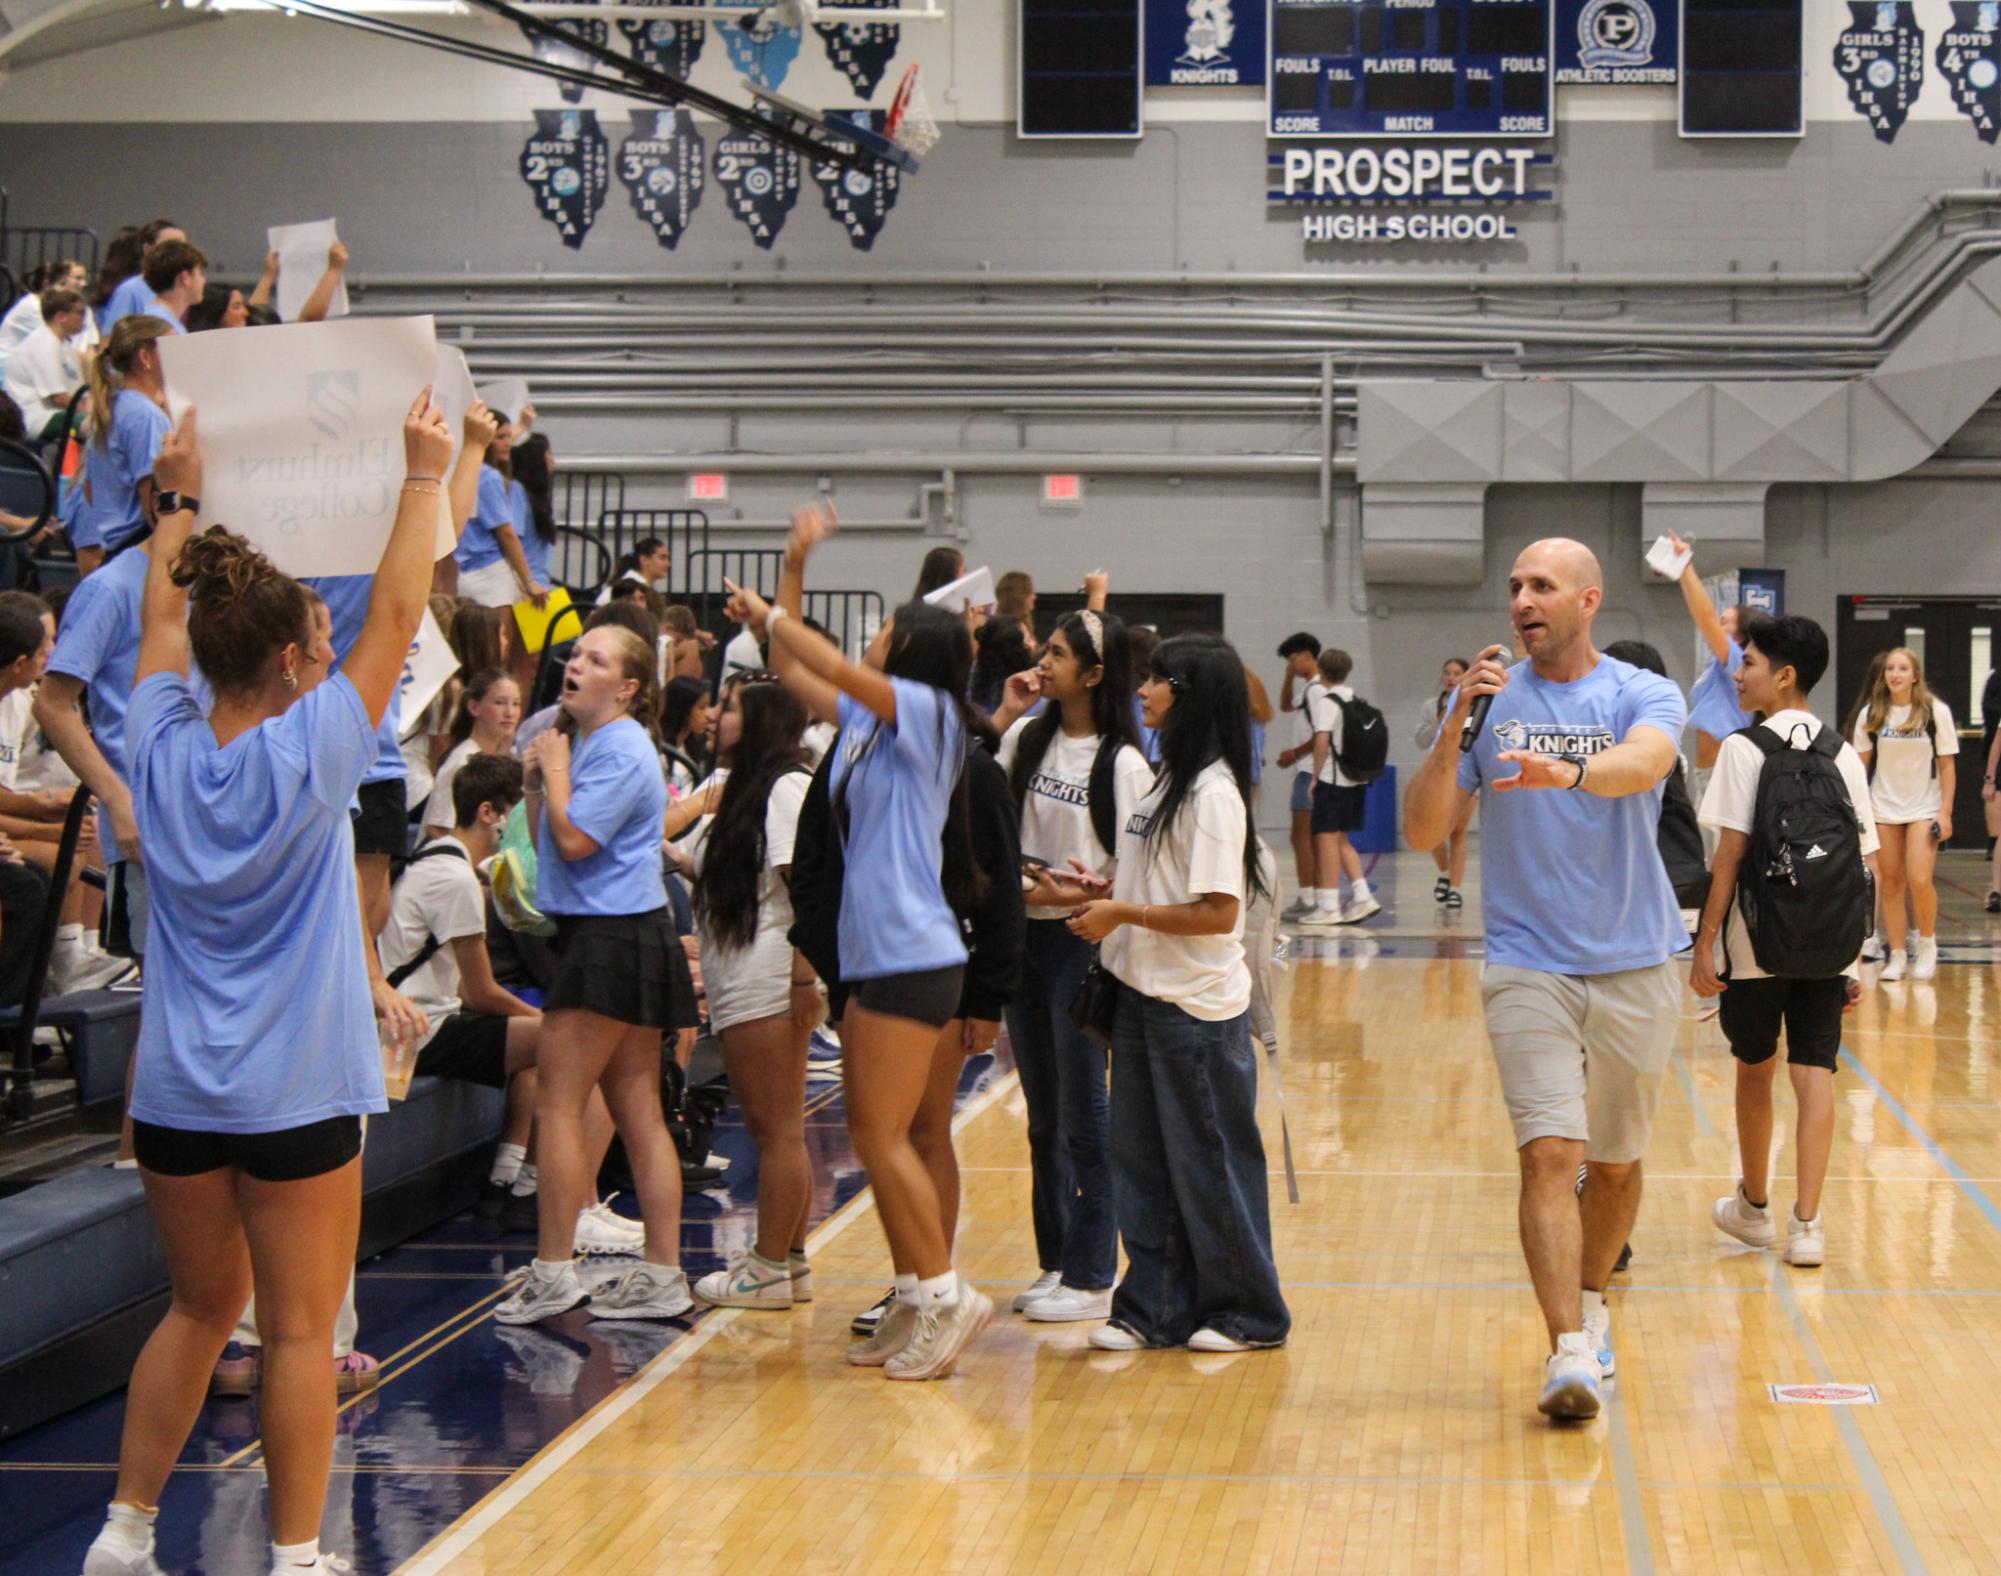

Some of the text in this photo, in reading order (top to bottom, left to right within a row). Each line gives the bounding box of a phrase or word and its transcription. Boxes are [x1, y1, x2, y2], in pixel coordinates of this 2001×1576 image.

[1841, 33, 1894, 46] GIRLS
[1945, 33, 1992, 46] BOYS
[1275, 58, 1320, 73] FOULS
[1363, 58, 1416, 73] PLAYER
[1501, 57, 1546, 72] FOULS
[1910, 37, 1921, 81] 1990
[1171, 69, 1238, 83] KNIGHTS
[1555, 68, 1676, 83] ATHLETIC BOOSTERS
[1275, 117, 1320, 131] SCORE
[1384, 117, 1433, 131] MATCH
[1499, 116, 1544, 131] SCORE
[529, 141, 575, 154] BOYS
[625, 141, 670, 154] BOYS
[719, 141, 771, 154] GIRLS
[1284, 148, 1535, 196] PROSPECT
[1303, 215, 1516, 239] HIGH SCHOOL
[1529, 734, 1612, 753] KNIGHTS
